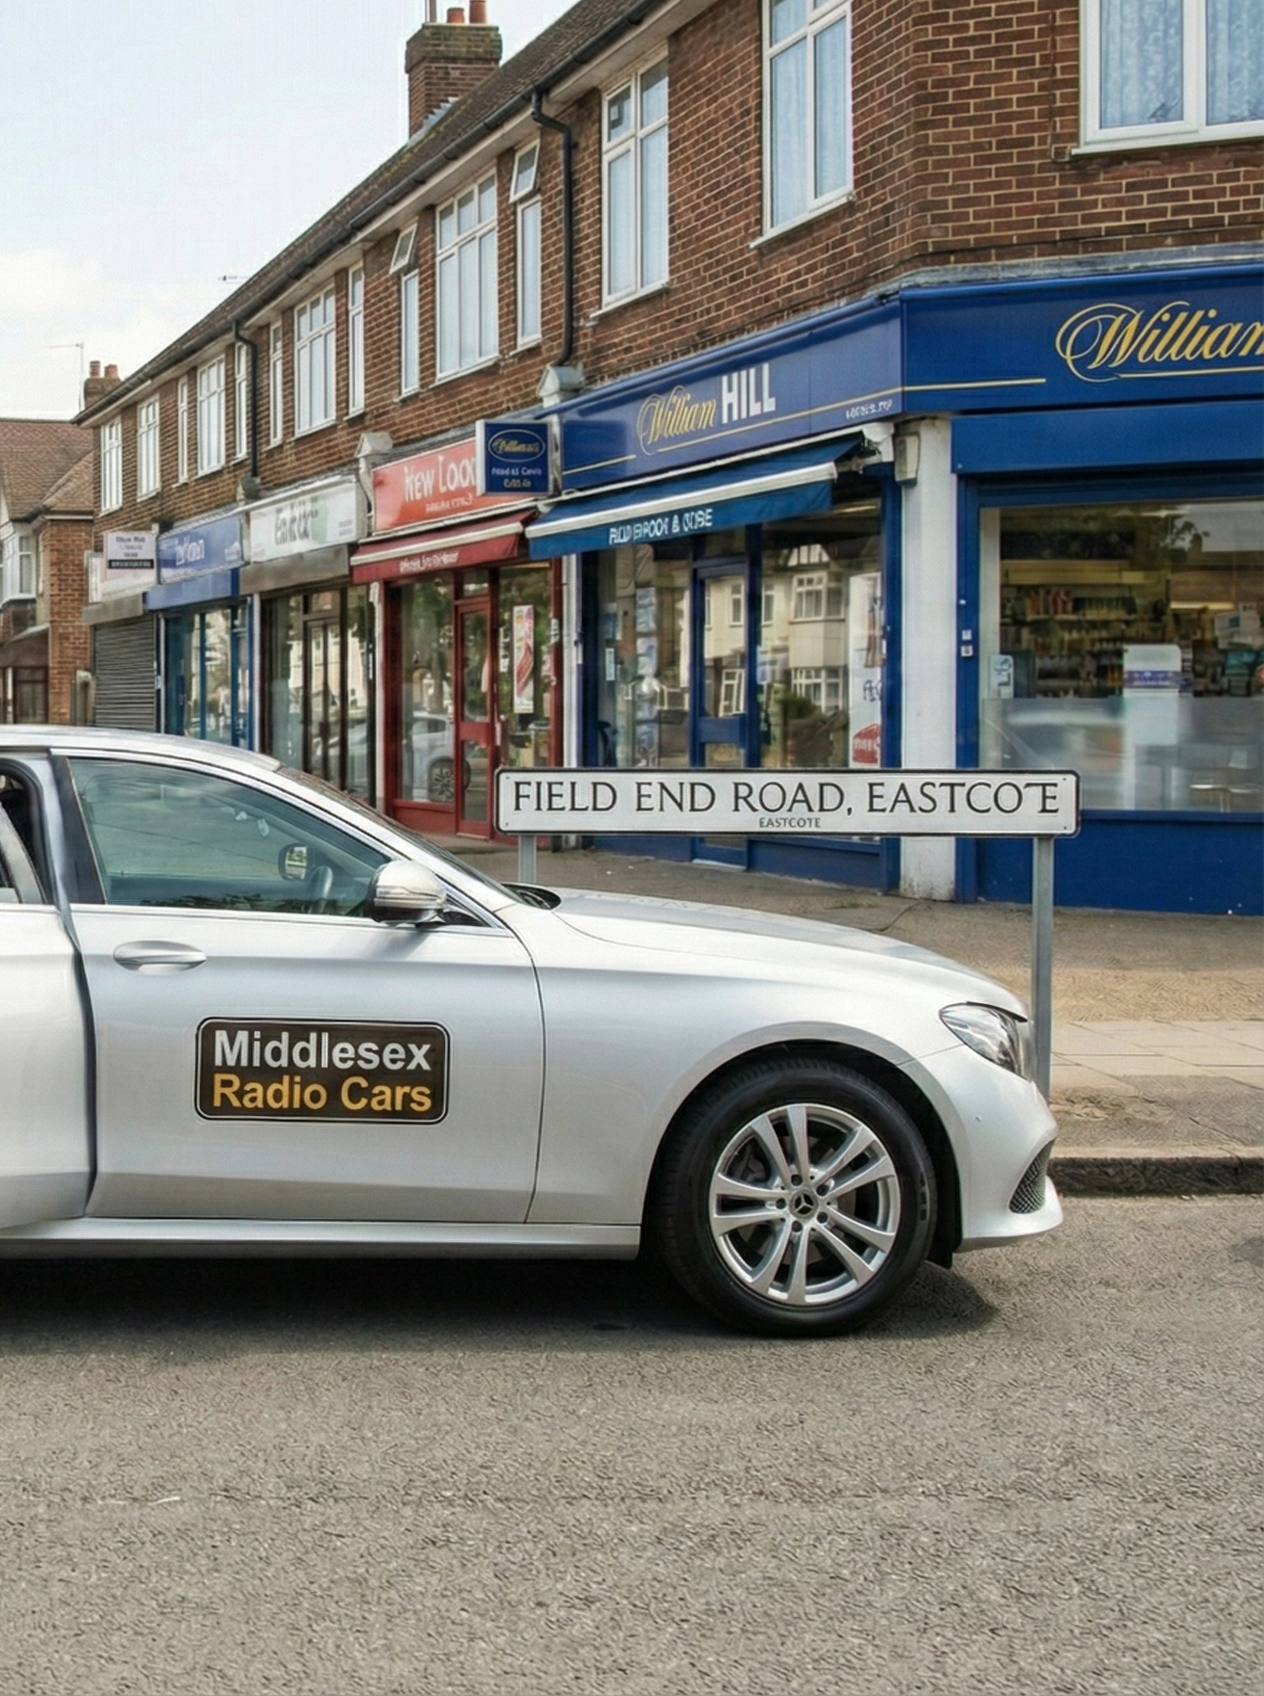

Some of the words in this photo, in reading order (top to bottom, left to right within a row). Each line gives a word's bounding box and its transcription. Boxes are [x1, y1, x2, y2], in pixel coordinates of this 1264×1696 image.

[637, 385, 717, 455] William
[721, 363, 777, 424] HILL
[513, 781, 618, 812] FIELD
[635, 781, 716, 812] END
[732, 781, 853, 816] ROAD,
[867, 781, 1060, 814] EASTCOTE
[759, 817, 821, 828] EASTCOTE
[214, 1029, 432, 1071] Middlesex
[213, 1073, 328, 1110] Radio
[341, 1076, 433, 1112] Cars
